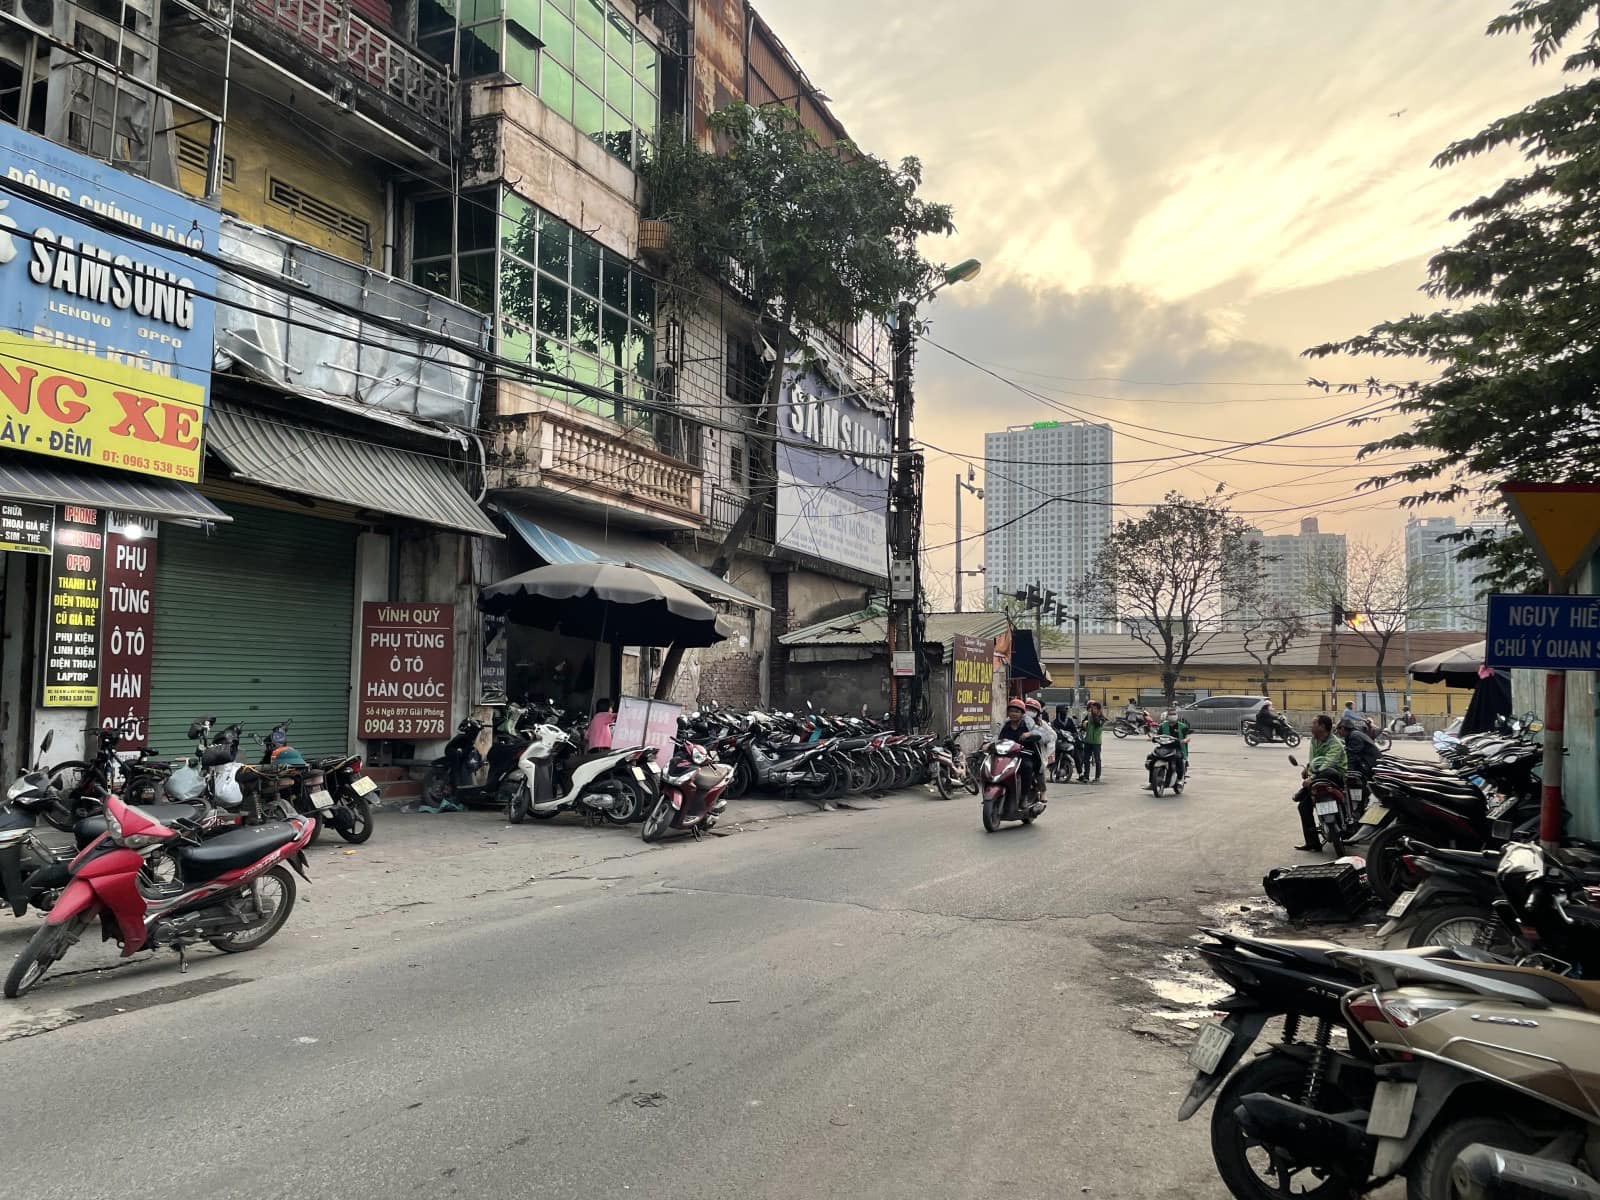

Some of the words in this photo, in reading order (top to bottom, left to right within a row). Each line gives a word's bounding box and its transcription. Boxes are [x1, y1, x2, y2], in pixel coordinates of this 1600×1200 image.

[30, 227, 195, 330] SAMSUNG
[49, 300, 111, 328] LENOVO
[137, 327, 182, 349] OPPO
[0, 363, 91, 424] NG
[109, 391, 199, 451] XE
[0, 414, 30, 444] ÀY
[49, 427, 92, 458] ĐÊM
[791, 383, 888, 479] SAMSUNG
[102, 449, 120, 464] ĐT:
[122, 454, 150, 470] 0963
[153, 459, 173, 474] 538
[176, 463, 196, 478] 555
[64, 504, 97, 526] IPHONE
[5, 530, 20, 541] SIM
[66, 553, 91, 573] OPPO
[116, 544, 147, 577] PHỤ
[58, 576, 86, 590] THANH
[110, 582, 149, 614] TÙNG
[377, 606, 410, 622] VĨNH
[1509, 605, 1560, 627] NGUY
[53, 645, 73, 655] LINH
[110, 625, 122, 655] Ô
[126, 626, 145, 656] TÔ
[370, 632, 401, 652] PHỤ
[404, 630, 445, 649] TÙNG
[1494, 633, 1526, 657] CHÚ
[1531, 633, 1543, 657] Ý
[1546, 639, 1592, 659] QUAN
[390, 655, 401, 672] Ô
[404, 655, 424, 673] TÔ
[57, 672, 89, 682] LAPTOP
[109, 668, 142, 698] HÀN
[367, 679, 399, 697] HÀN
[402, 676, 445, 699] QUỐC
[364, 719, 395, 734] 0904
[397, 719, 412, 734] 33
[415, 719, 445, 734] 7978
